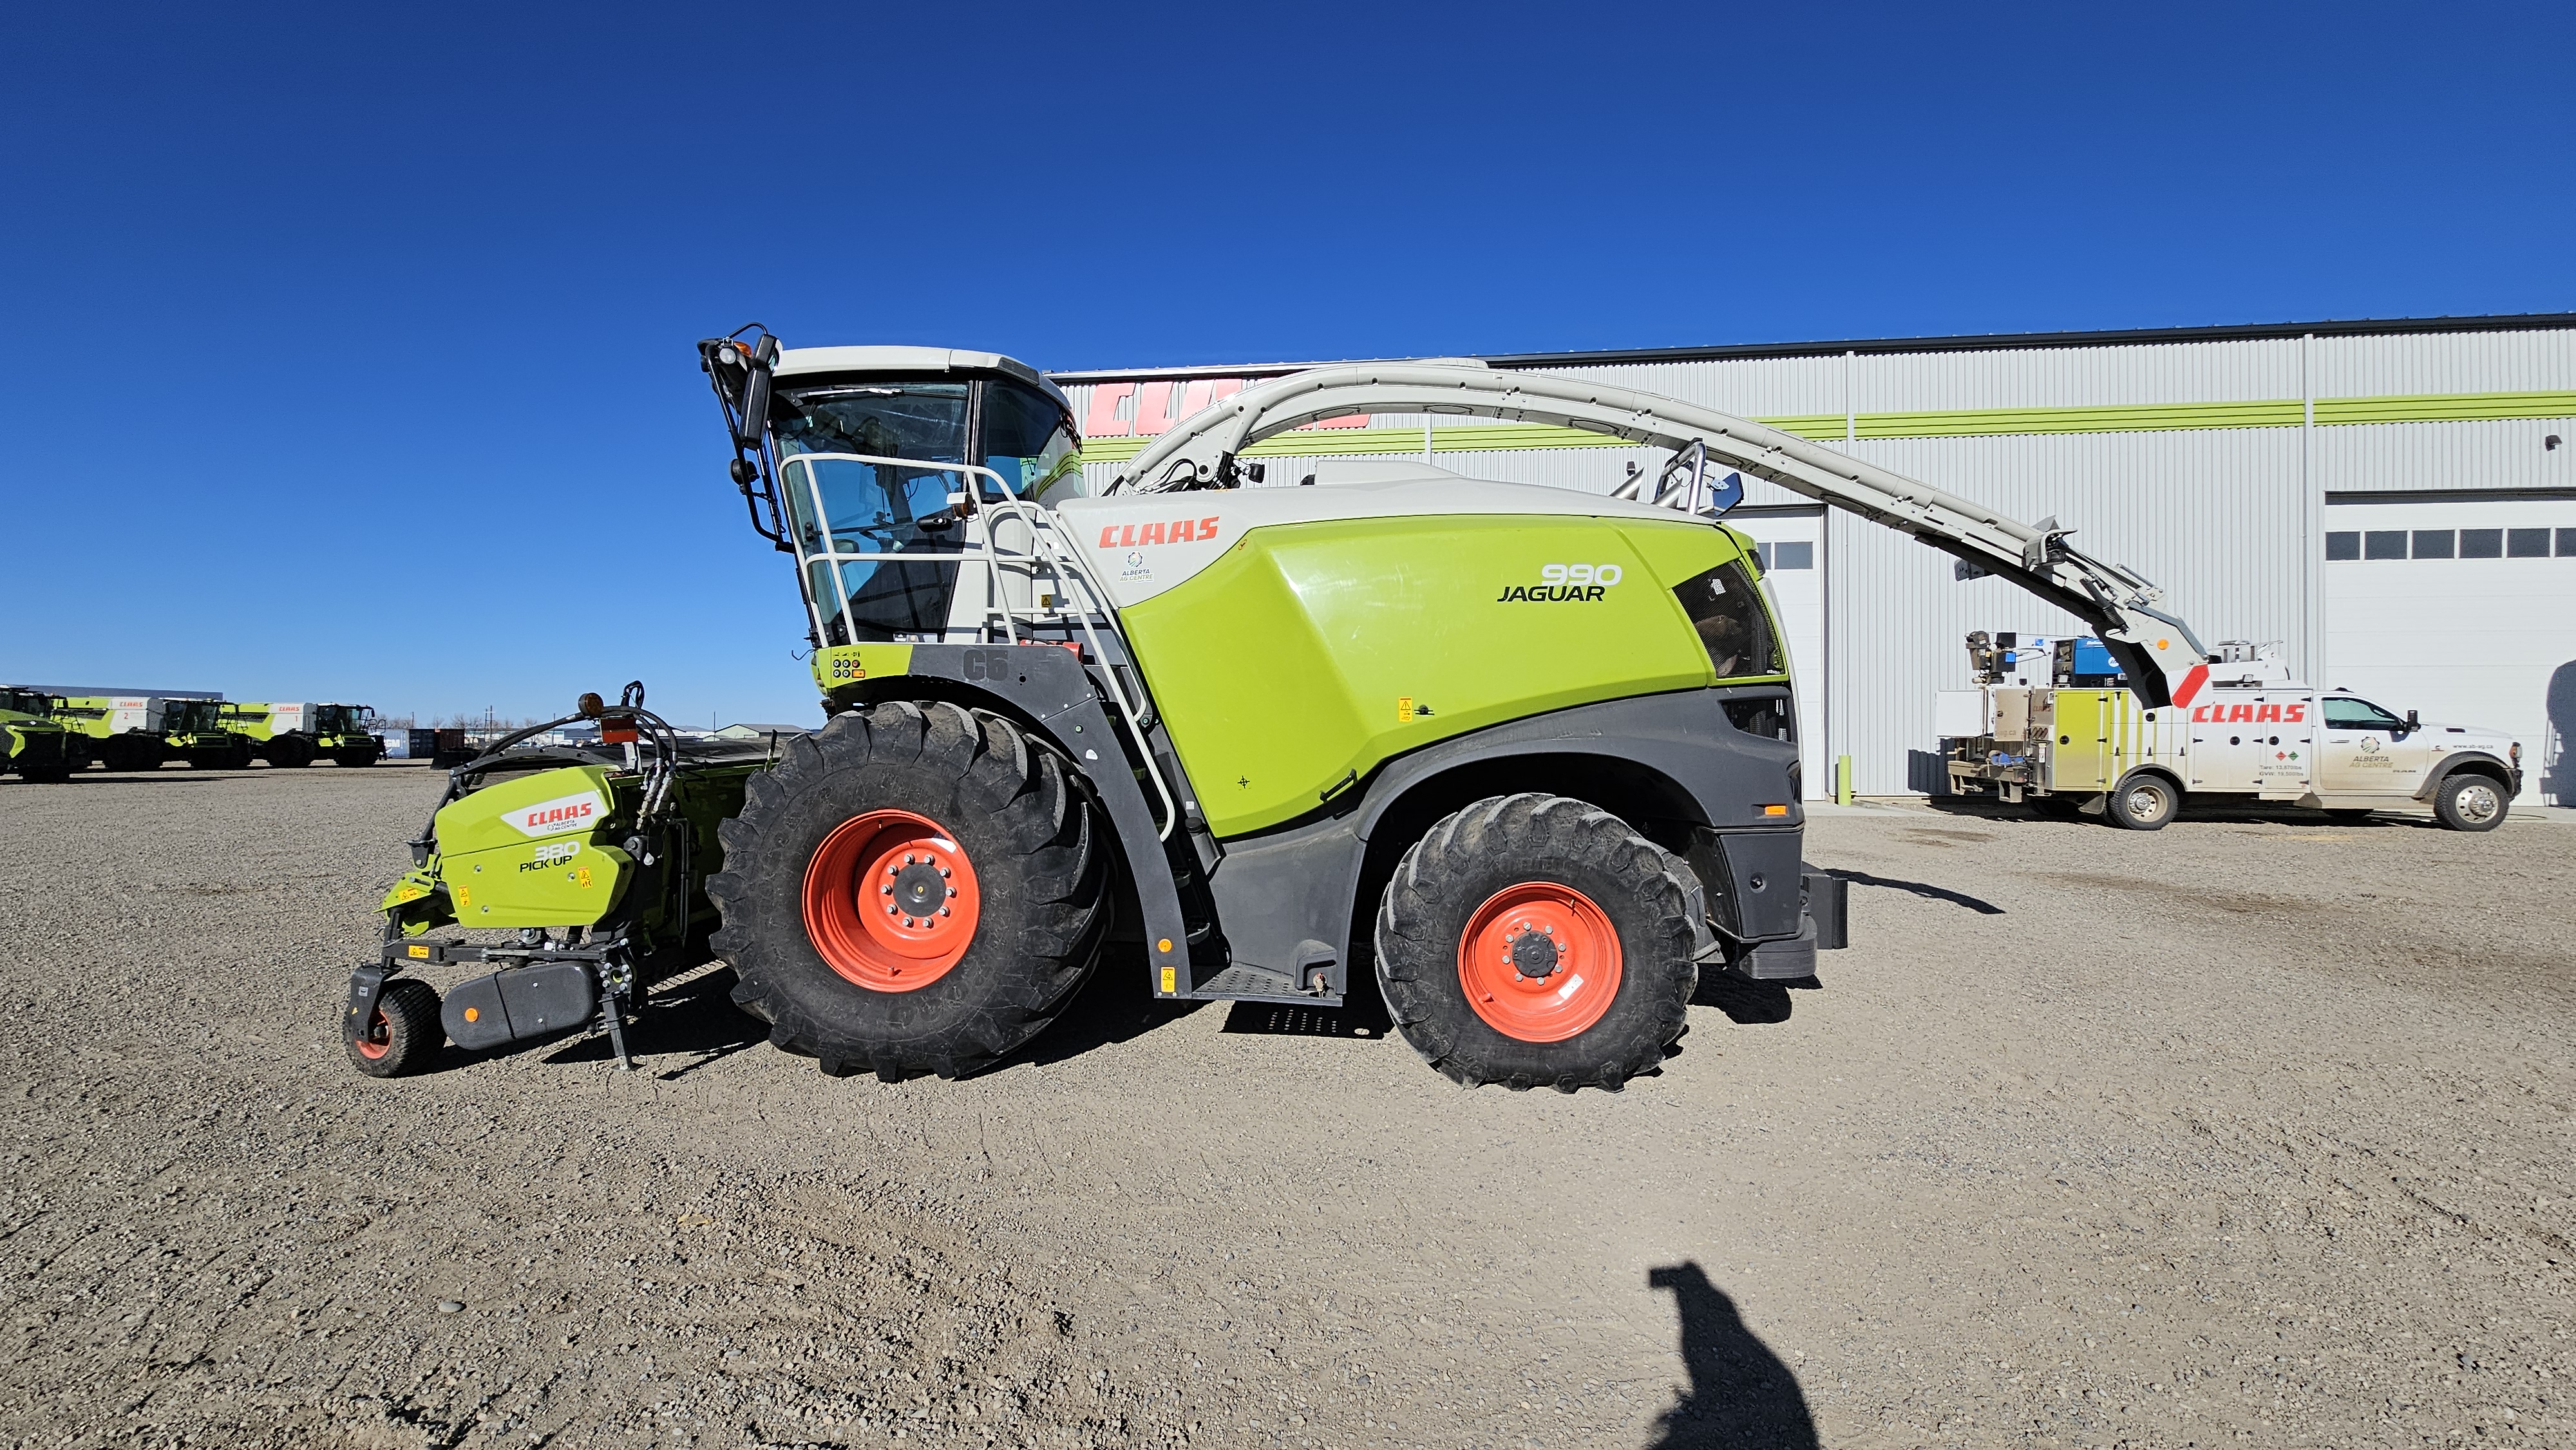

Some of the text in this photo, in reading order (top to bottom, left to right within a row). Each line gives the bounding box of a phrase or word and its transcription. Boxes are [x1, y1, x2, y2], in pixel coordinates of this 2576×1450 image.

[1099, 516, 1220, 548] CLAAS
[1542, 564, 1622, 586] 990
[1497, 585, 1605, 602] JAGUAR
[2192, 704, 2306, 723] CLAAS
[527, 802, 592, 827] CLAAS
[535, 841, 580, 861] 380
[520, 855, 573, 872] PICK UP
